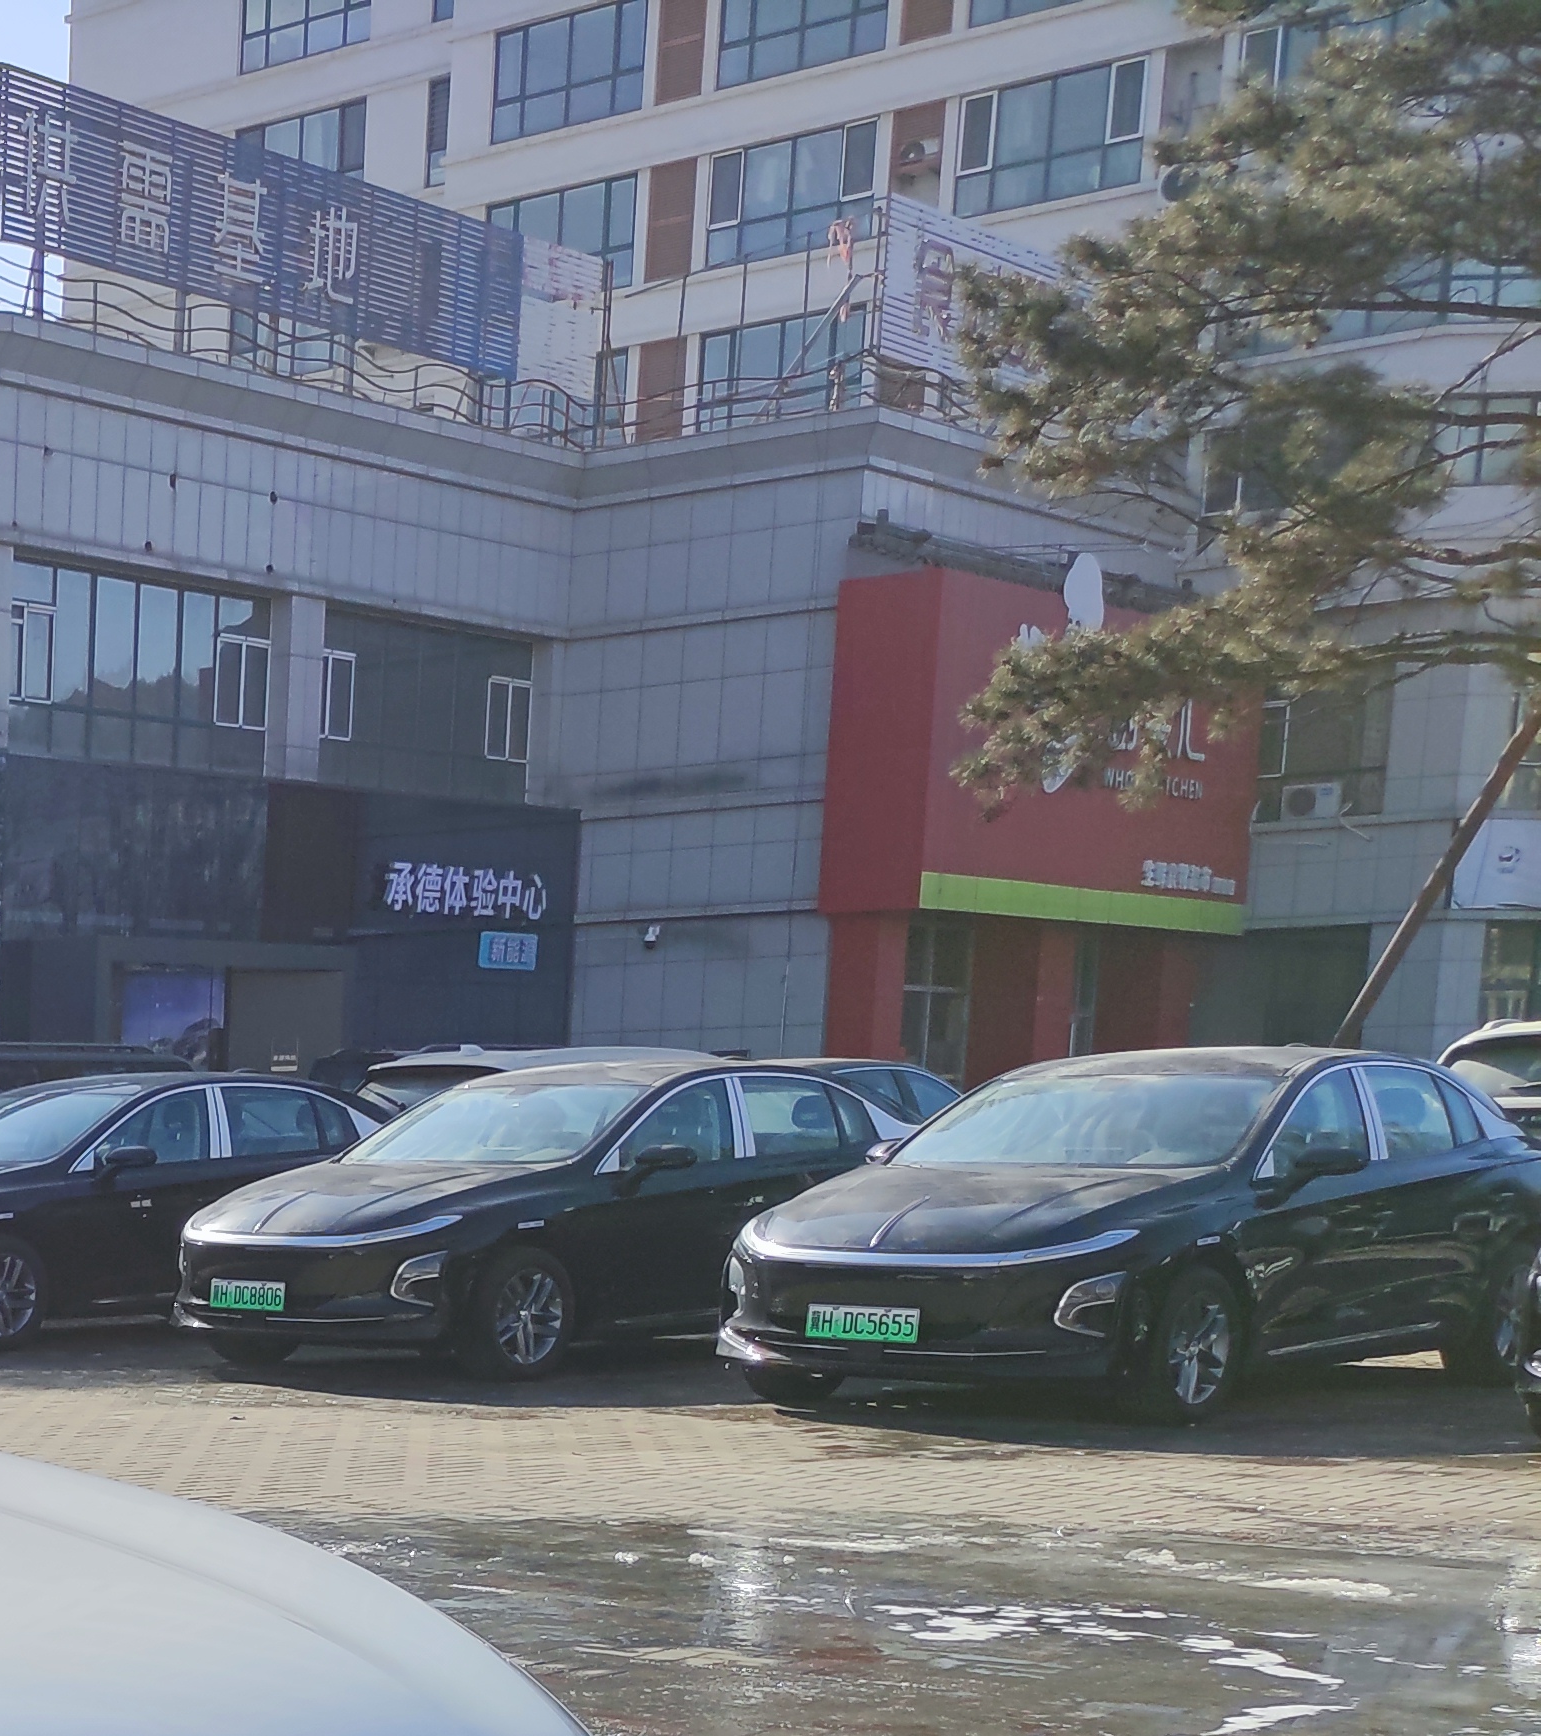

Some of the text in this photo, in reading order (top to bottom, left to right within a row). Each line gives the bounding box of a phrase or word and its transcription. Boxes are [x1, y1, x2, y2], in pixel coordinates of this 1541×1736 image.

[385, 861, 547, 921] 承德体验中心
